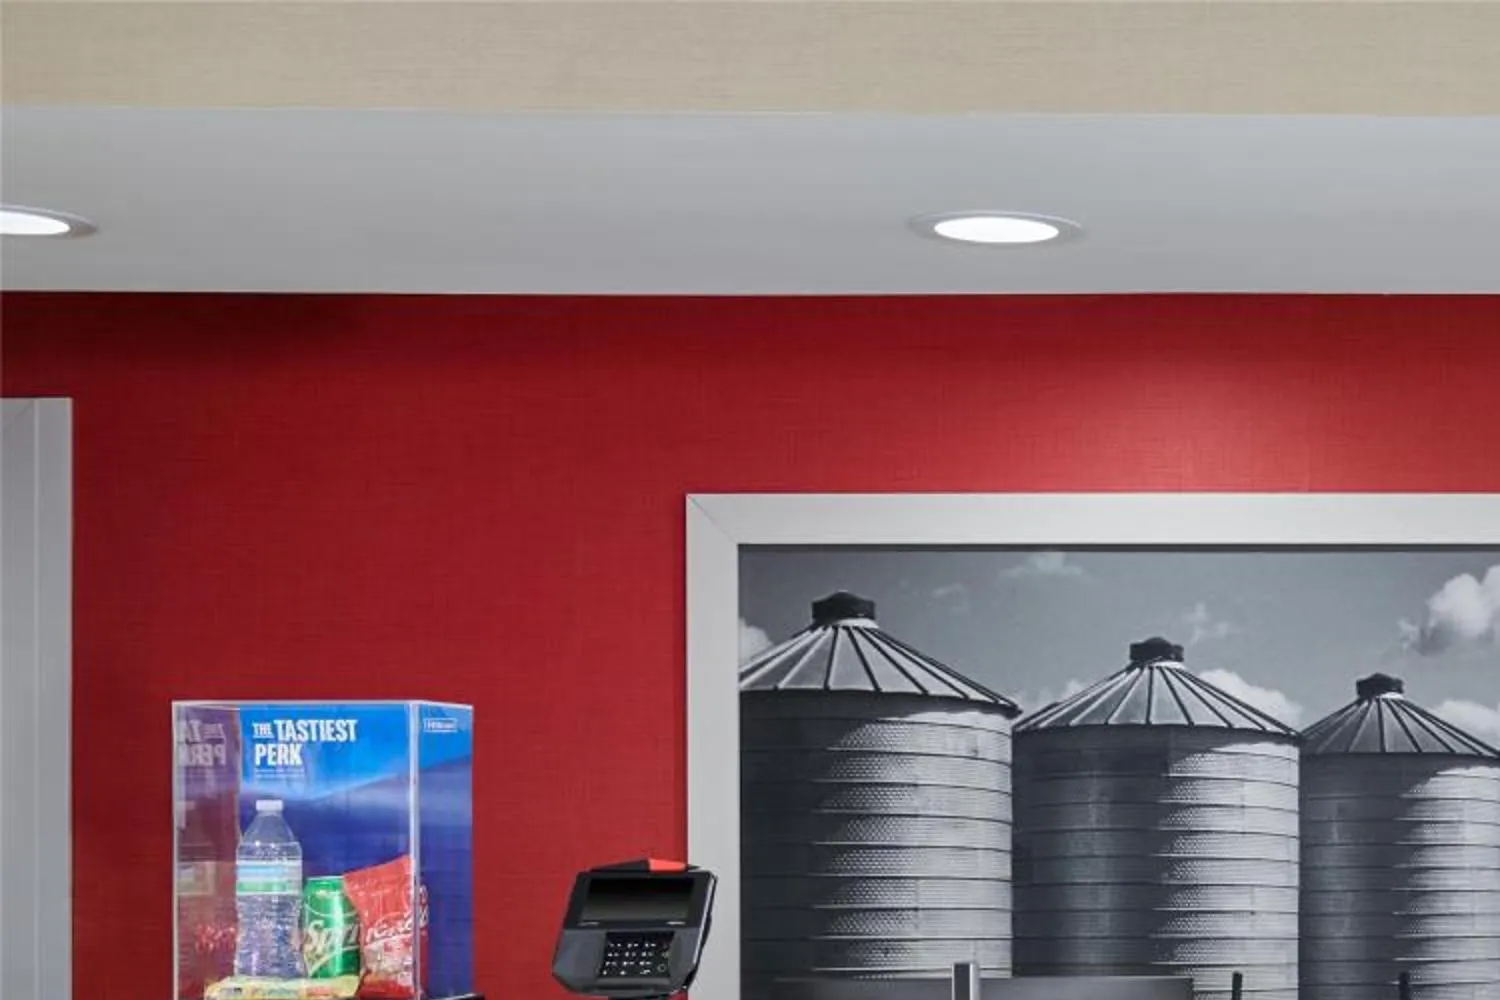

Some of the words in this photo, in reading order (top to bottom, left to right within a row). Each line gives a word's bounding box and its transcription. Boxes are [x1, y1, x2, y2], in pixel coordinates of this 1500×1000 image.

[252, 722, 274, 738] THE
[274, 719, 358, 742] TASTIEST
[254, 743, 303, 766] PERK
